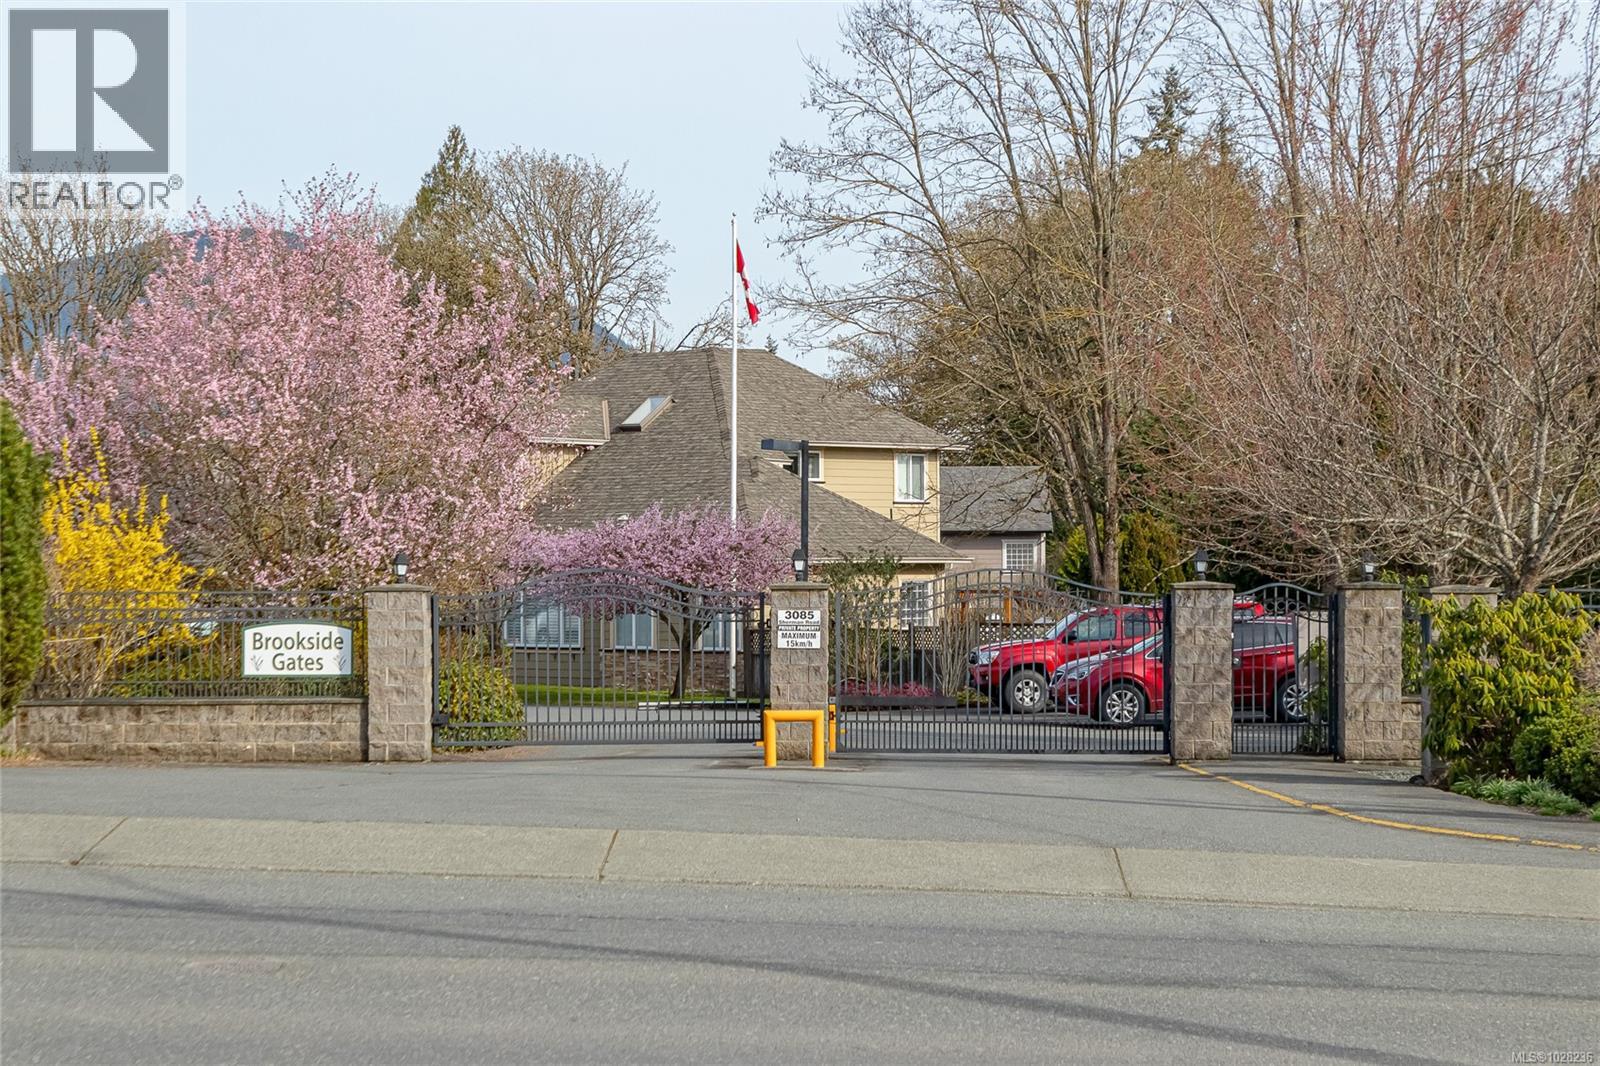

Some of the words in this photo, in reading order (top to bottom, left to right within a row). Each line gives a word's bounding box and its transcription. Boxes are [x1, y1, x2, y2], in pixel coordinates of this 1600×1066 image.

[785, 611, 814, 620] 3085
[252, 631, 344, 650] Brookside
[781, 632, 816, 640] MAXIMUM
[272, 653, 324, 671] Gates
